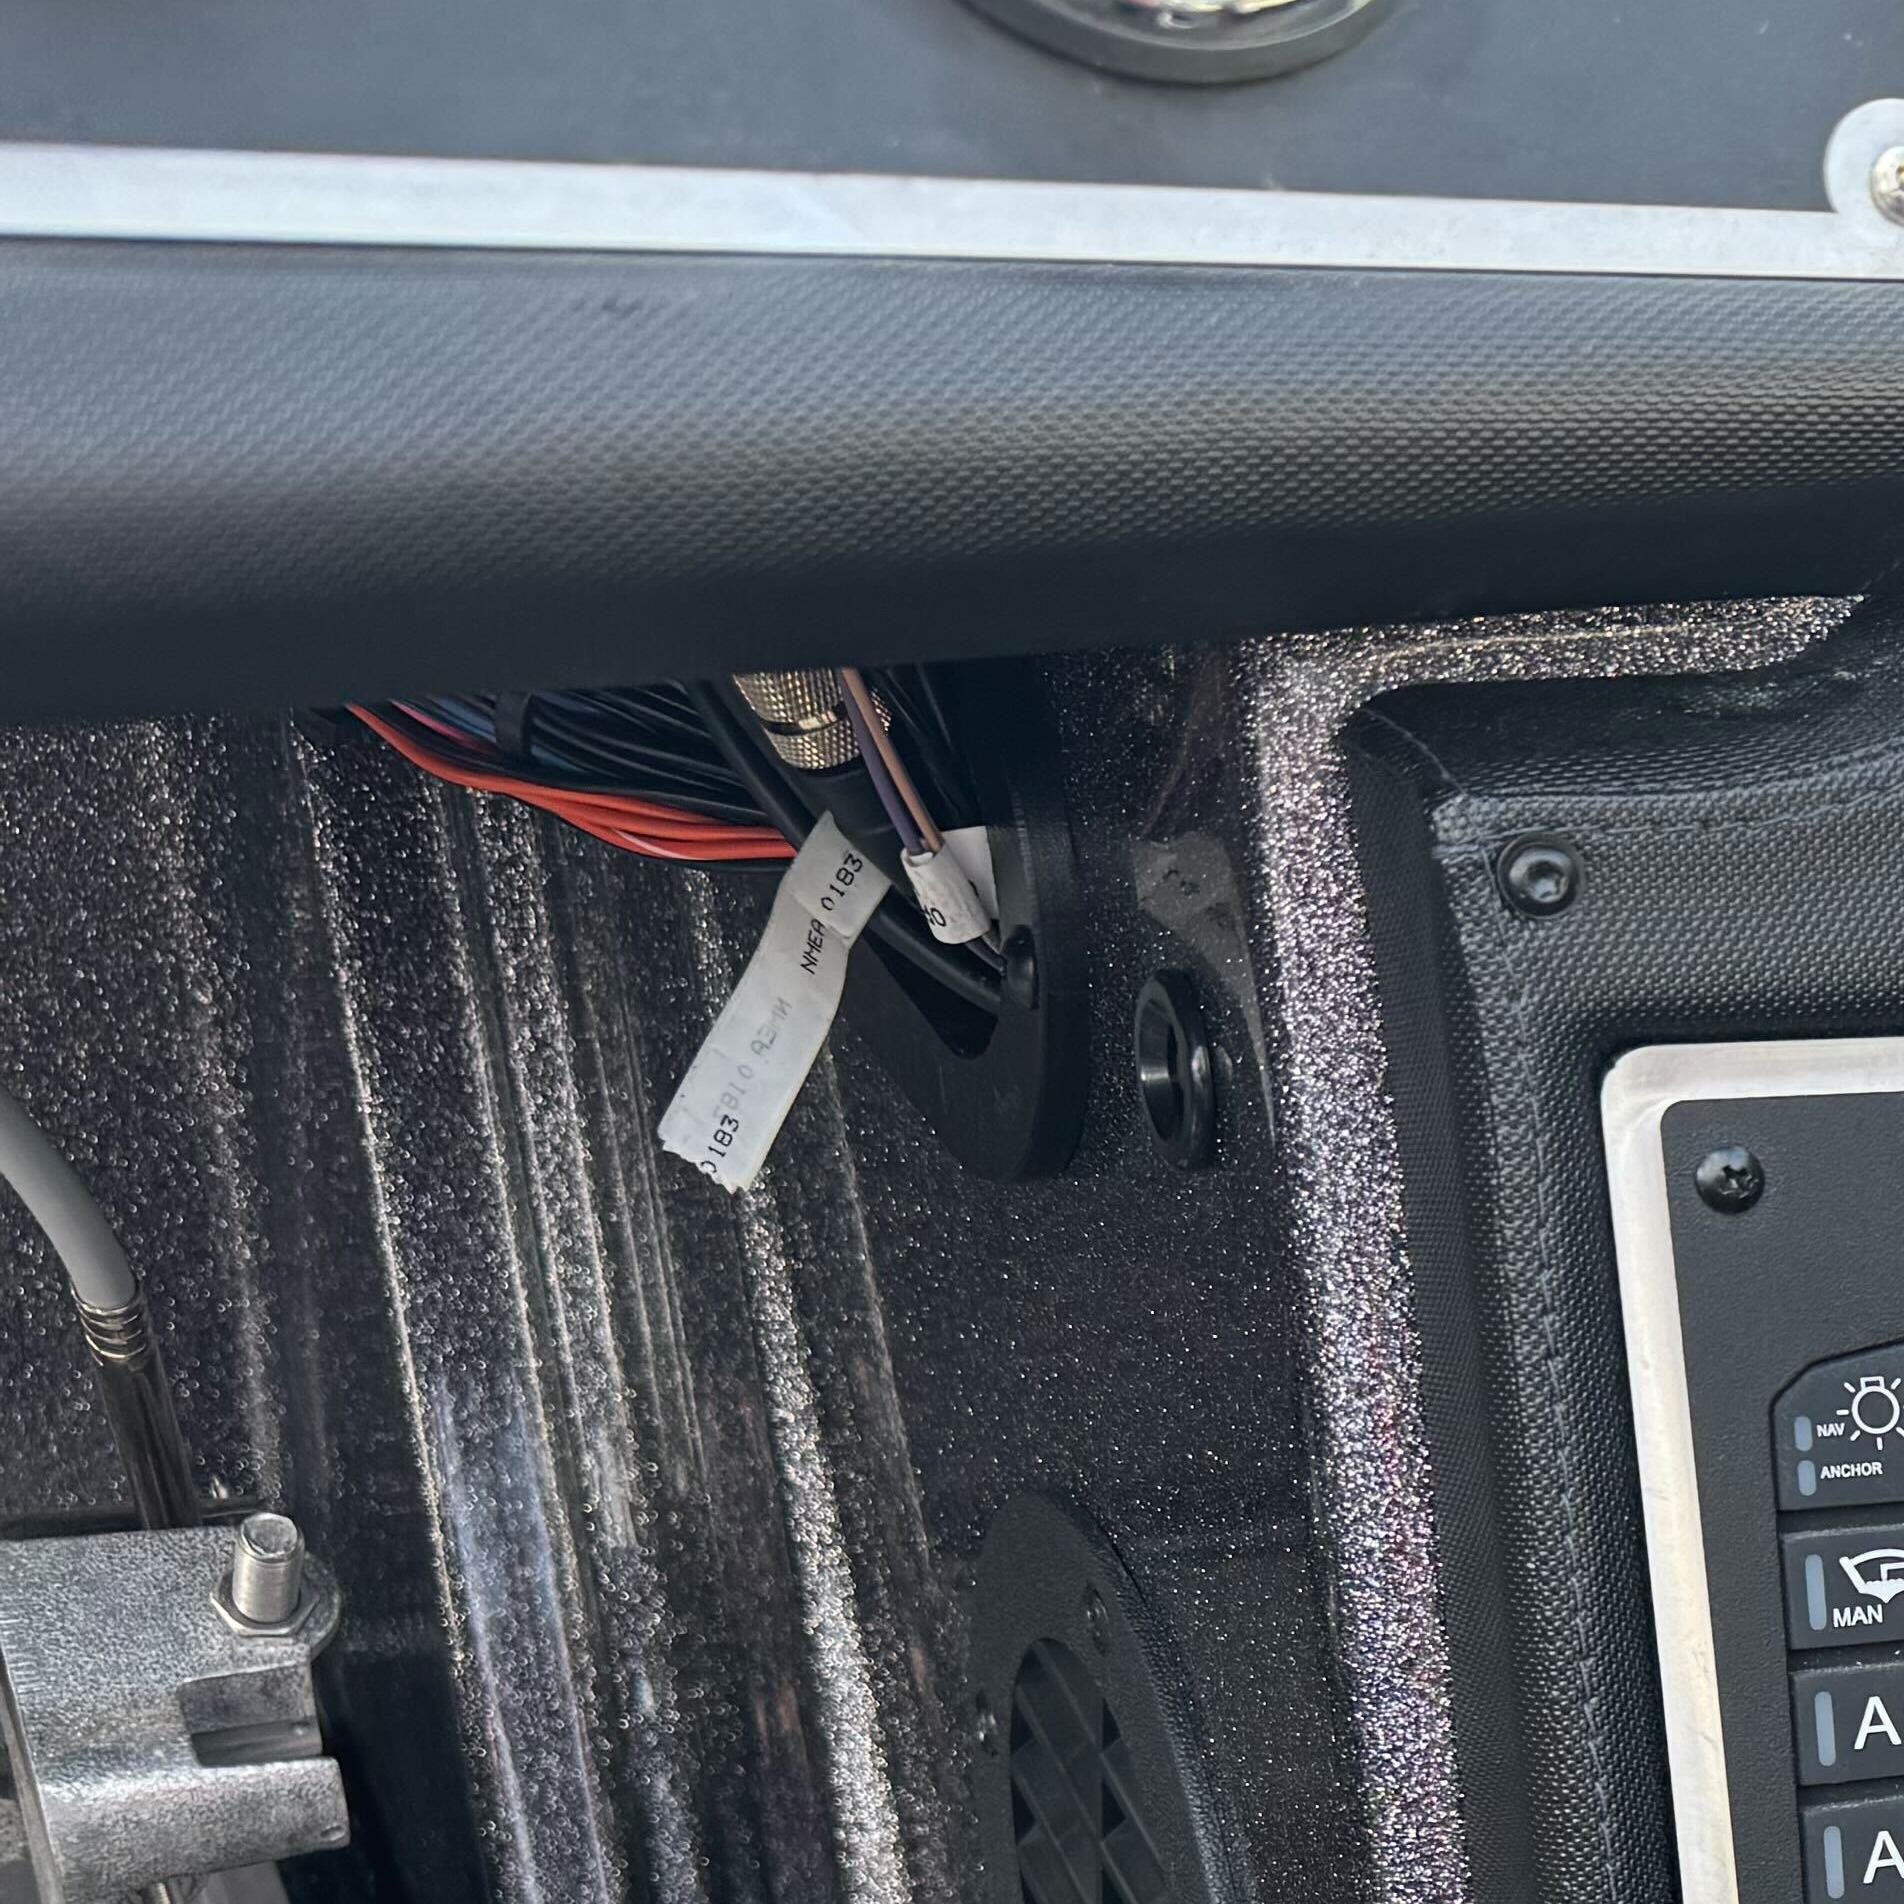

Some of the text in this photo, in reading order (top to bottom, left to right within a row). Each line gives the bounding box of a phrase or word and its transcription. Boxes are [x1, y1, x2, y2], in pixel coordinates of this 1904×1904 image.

[800, 853, 863, 975] NMEA 0183
[1816, 1422, 1846, 1438] NAV
[1820, 1461, 1883, 1479] ANCHOR
[1832, 1604, 1883, 1628] MAN
